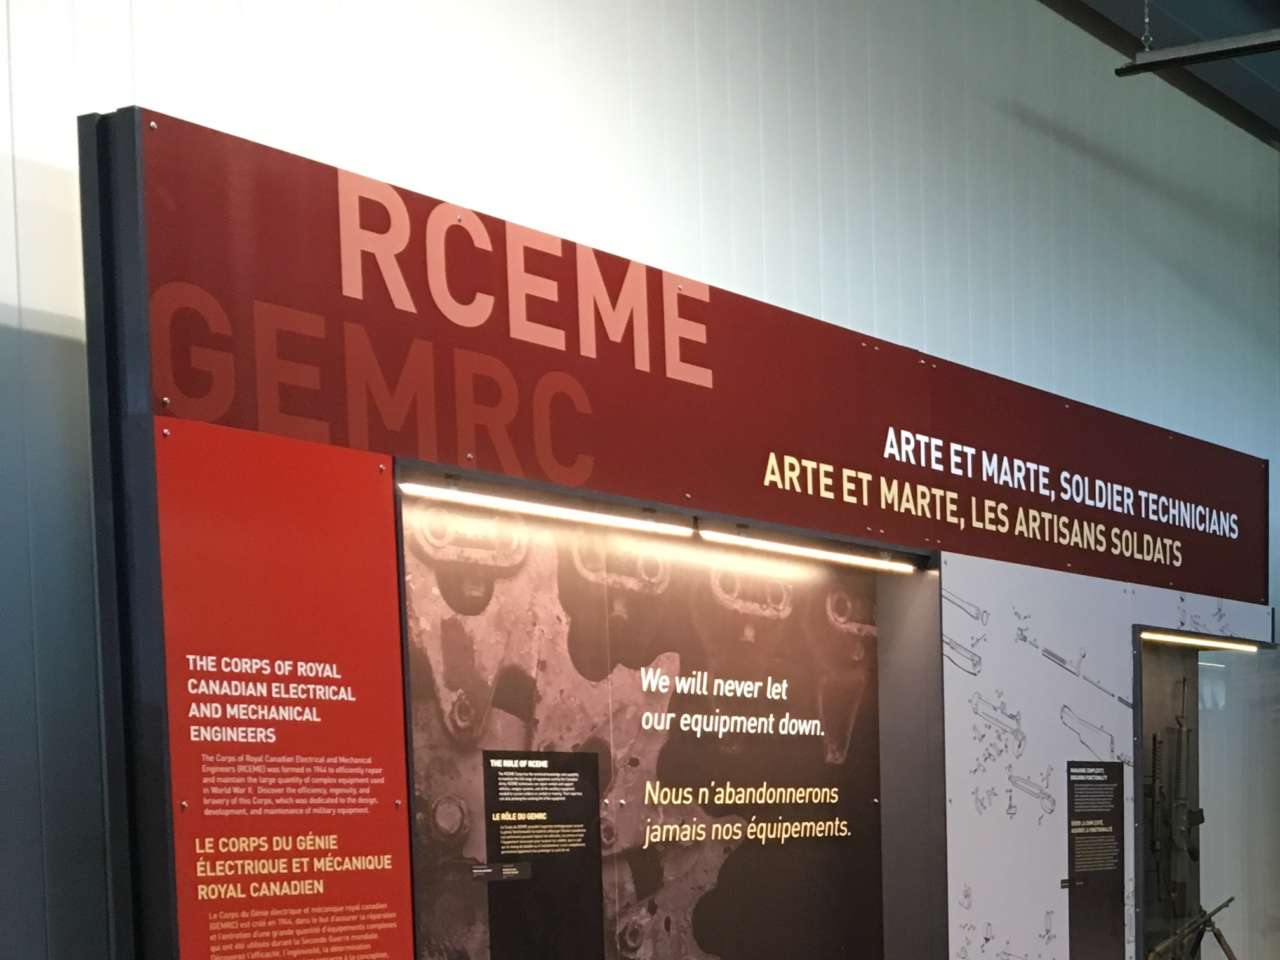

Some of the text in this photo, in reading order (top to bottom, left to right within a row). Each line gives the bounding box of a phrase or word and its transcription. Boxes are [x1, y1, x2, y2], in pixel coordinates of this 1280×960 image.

[338, 168, 713, 388] RCEME
[152, 281, 595, 487] GEMRC
[883, 426, 1239, 539] ARTE ET MARTE, SOLDIER TECHNICIANS
[763, 452, 1183, 568] ARTE ET MARTE, LES ARTISANS SOLDATS
[186, 655, 341, 678] THE CORPS OF ROYAL
[188, 679, 356, 701] CANADIAN ELECTRICAL
[640, 667, 788, 700] We will never let
[188, 703, 321, 721] AND MECHANICAL
[642, 709, 825, 738] our equipment down.
[190, 726, 276, 743] ENGINEERS
[644, 781, 839, 804] Nous n'abandonnerons
[196, 832, 338, 853] LE CORPS DU GÉNIE
[643, 816, 851, 849] jamais nos équipements.
[197, 853, 392, 877] ÉLECTRIQUE ET MÉCANIQUE
[198, 880, 323, 899] ROYAL CANADIEN
